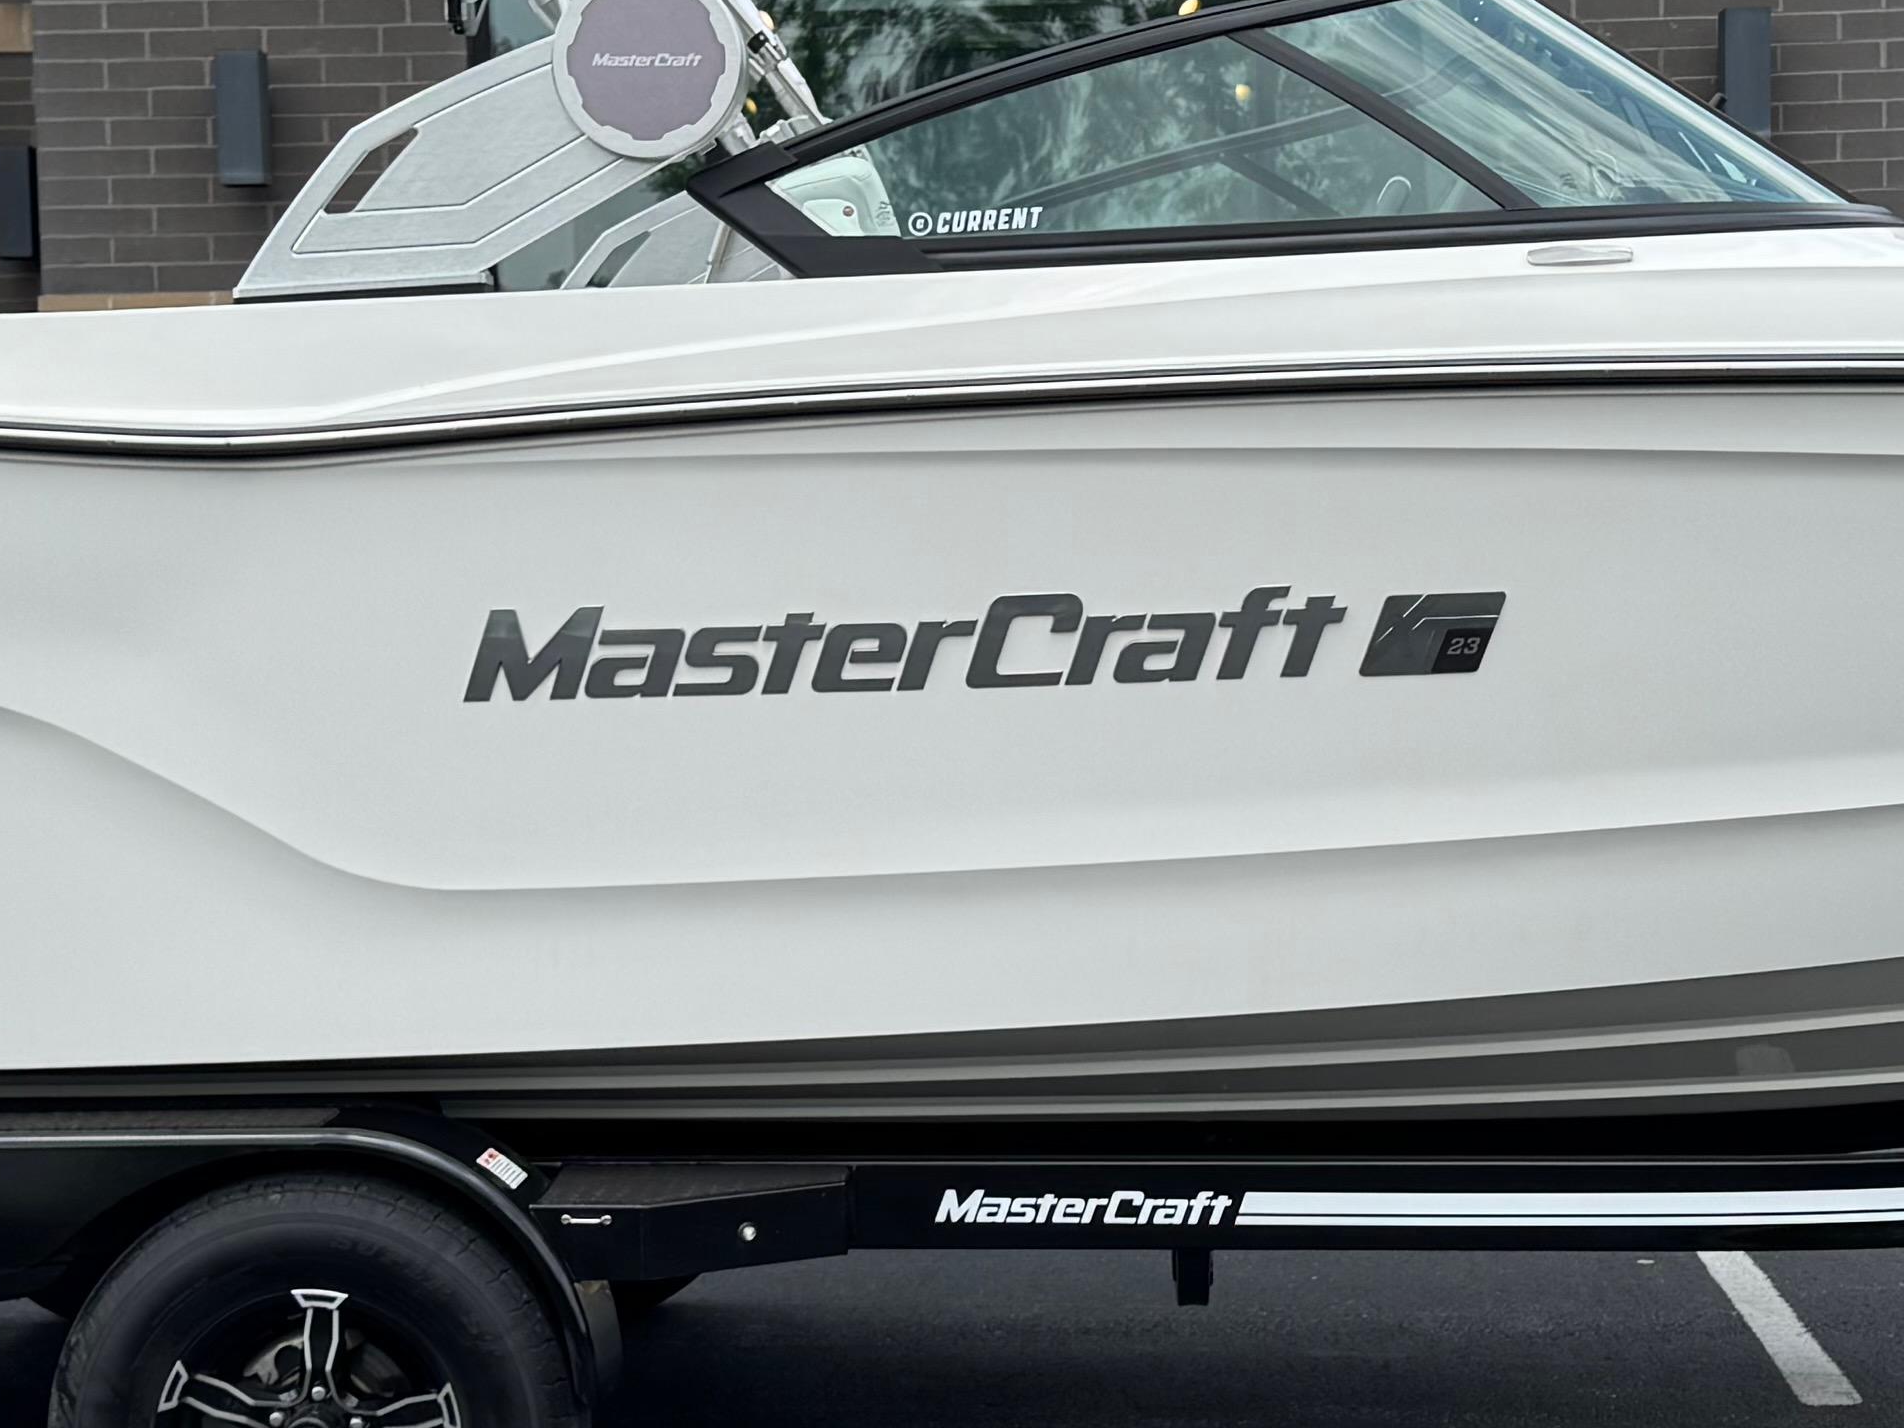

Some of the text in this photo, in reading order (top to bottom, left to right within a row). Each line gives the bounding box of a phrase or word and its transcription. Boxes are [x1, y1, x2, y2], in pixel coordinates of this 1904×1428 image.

[592, 52, 703, 68] MasterCraft
[936, 206, 1043, 233] CURRENT
[463, 586, 1347, 702] MasterCraft
[1447, 637, 1481, 655] 23
[935, 1188, 1232, 1226] MasterCraft
